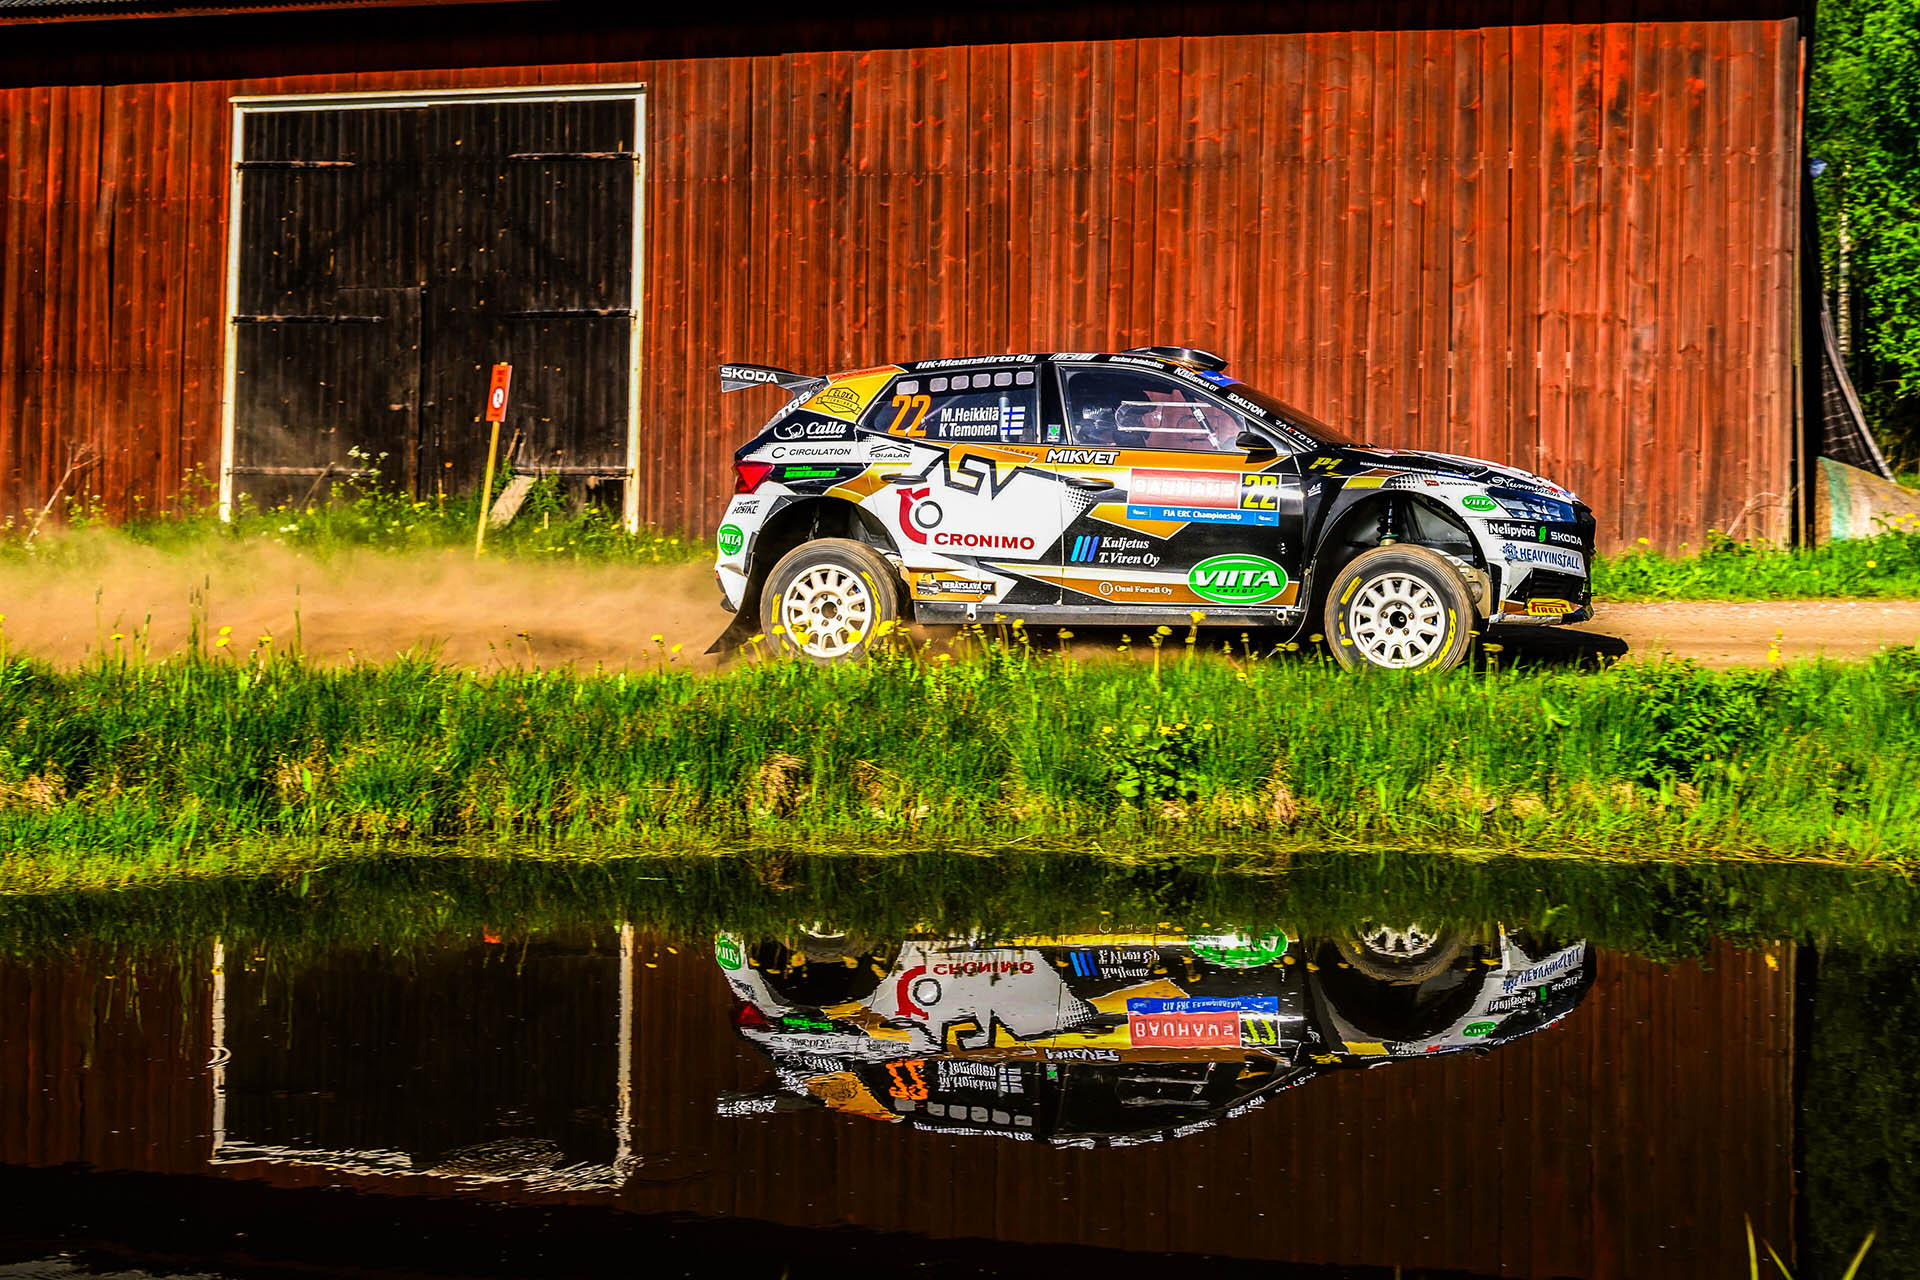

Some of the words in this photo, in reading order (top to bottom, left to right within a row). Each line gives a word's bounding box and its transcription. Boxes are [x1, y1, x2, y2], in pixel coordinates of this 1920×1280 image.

[915, 356, 1012, 370] HK-Maansiirto
[1015, 353, 1036, 364] Oy
[721, 367, 779, 383] SKODA
[887, 394, 932, 438] 22
[940, 407, 999, 422] M.Heikkilä
[806, 421, 847, 435] Calla
[938, 423, 948, 437] K
[949, 422, 998, 437] Temonen
[789, 448, 851, 456] CIRCULATION
[1046, 450, 1120, 465] MIKVET
[1243, 475, 1278, 509] 22
[1163, 509, 1175, 517] FIA
[1192, 511, 1242, 520] Championship
[1489, 523, 1537, 537] Nelipyörä
[934, 532, 1035, 550] CRONIMO
[1101, 537, 1150, 550] Kuljetus
[1550, 531, 1582, 546] SKODA
[1098, 552, 1142, 565] T.Viren
[1143, 553, 1160, 567] Oy
[1520, 548, 1580, 570] HEAVYINSTALL
[1194, 570, 1280, 588] VIITA
[1161, 587, 1173, 595] Oy
[1531, 601, 1573, 615] PIRELLI
